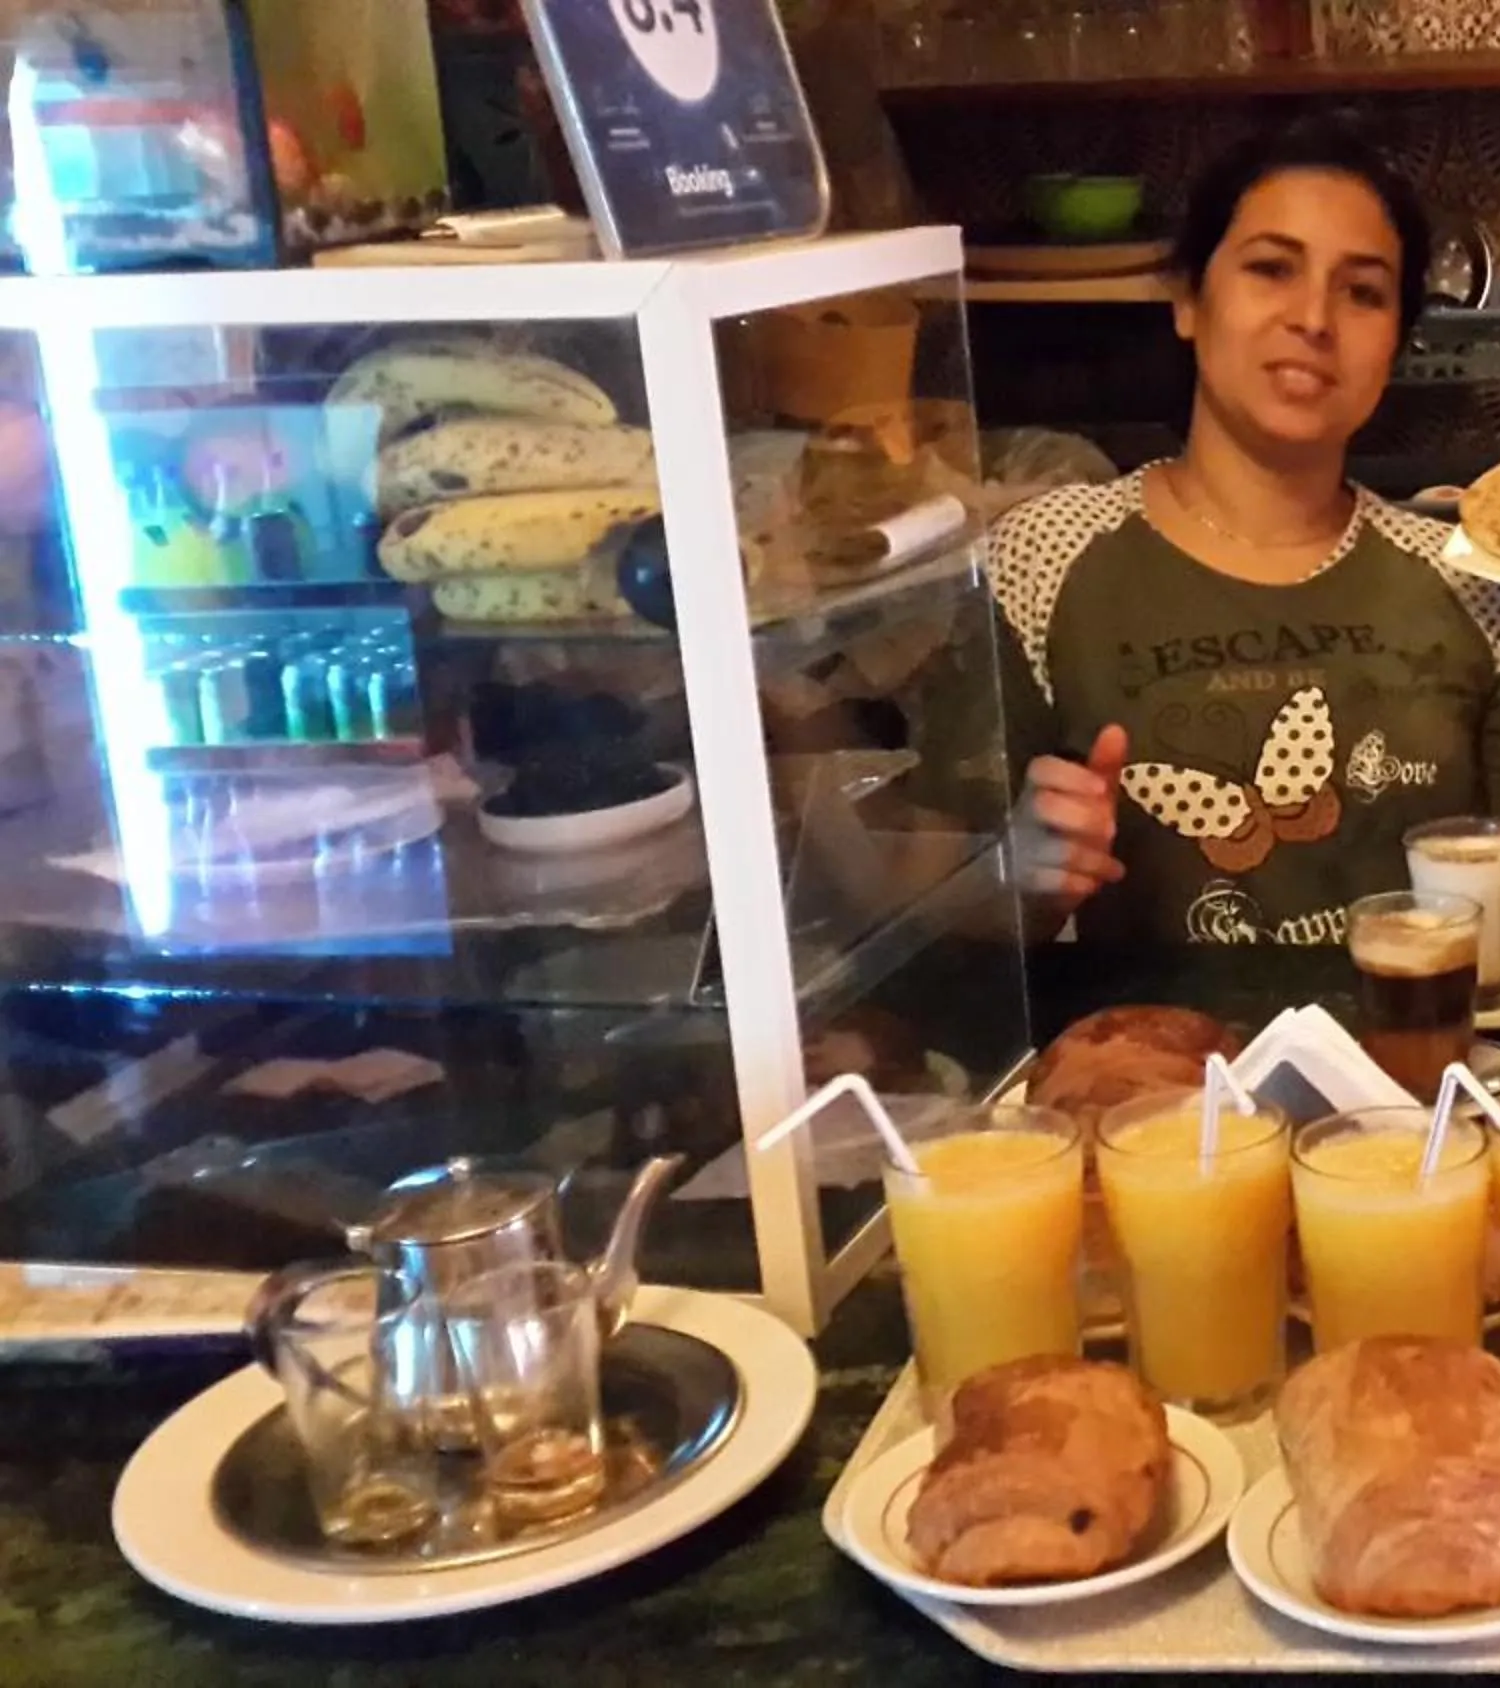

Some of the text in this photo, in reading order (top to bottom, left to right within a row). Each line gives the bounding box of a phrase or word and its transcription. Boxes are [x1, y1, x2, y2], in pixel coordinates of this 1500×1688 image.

[1151, 623, 1379, 676] ESCAPE
[1206, 669, 1276, 692] AND
[1346, 731, 1438, 802] Love
